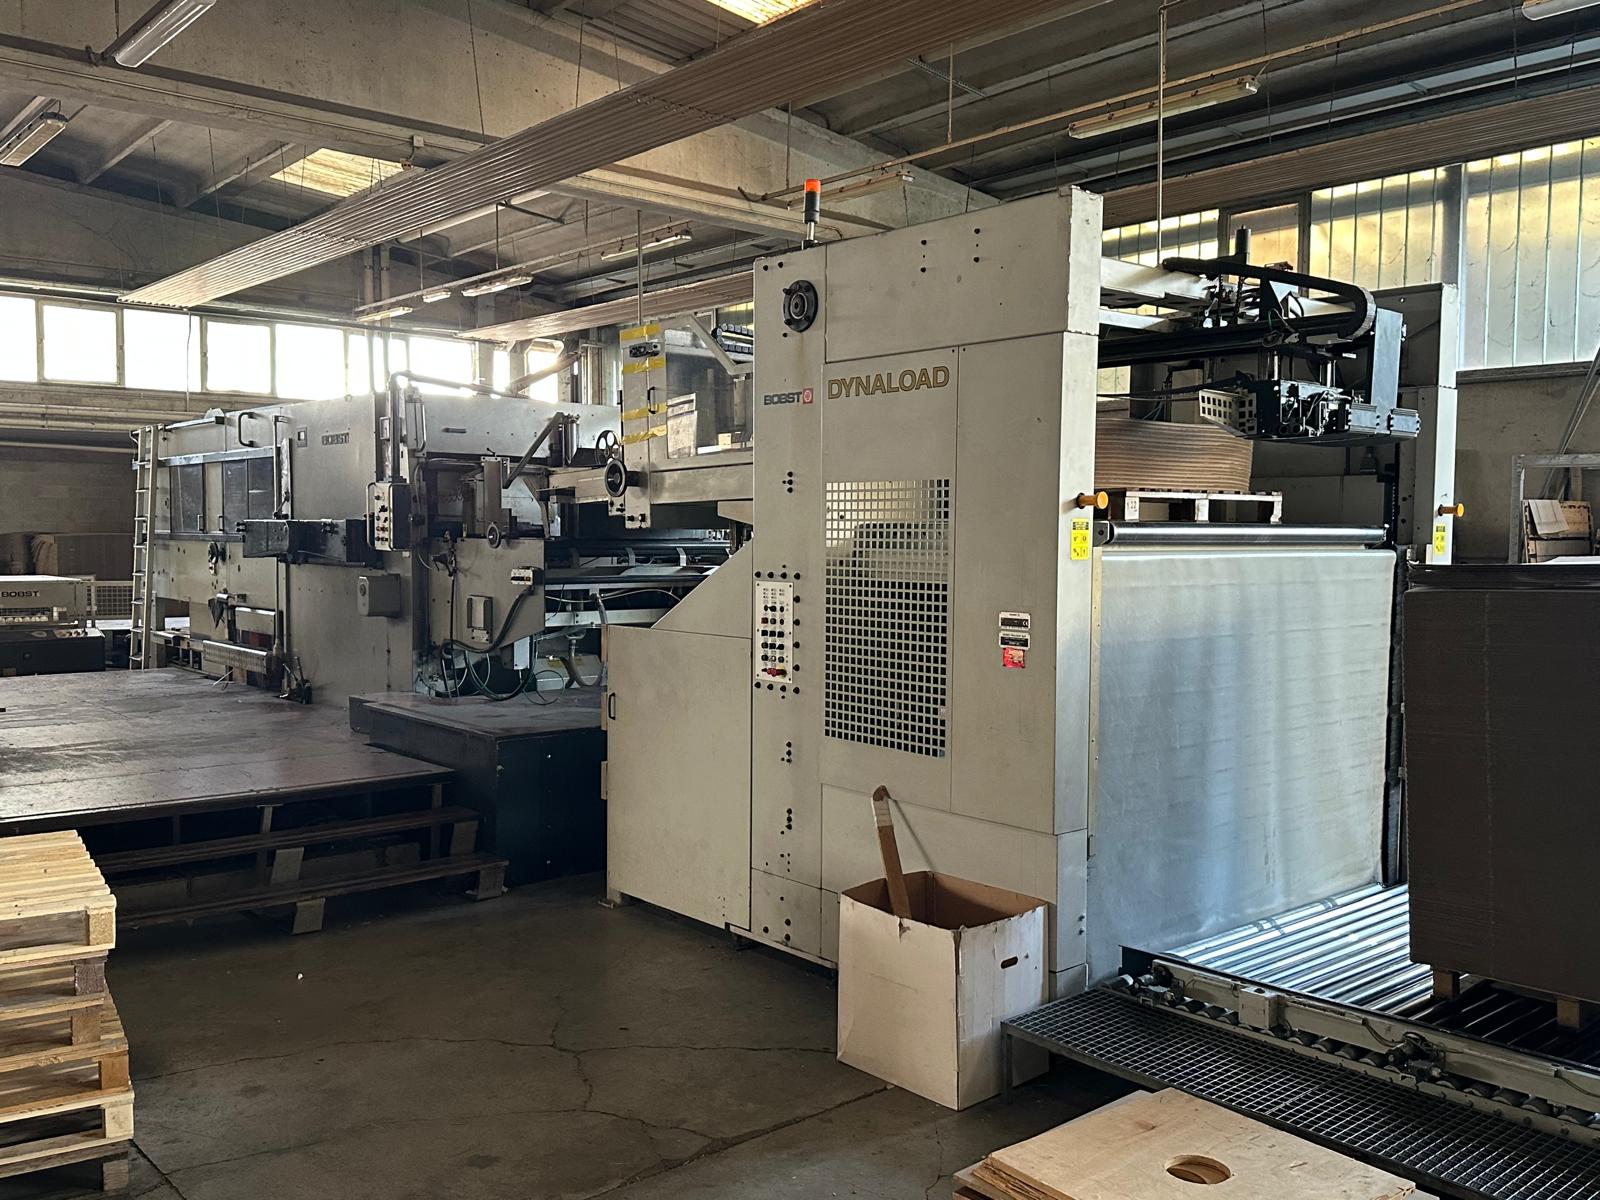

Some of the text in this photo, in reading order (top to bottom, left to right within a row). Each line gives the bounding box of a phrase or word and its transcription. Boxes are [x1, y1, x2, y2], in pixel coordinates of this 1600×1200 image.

[828, 366, 950, 400] DYNALOAD
[764, 391, 802, 405] BOBST
[322, 432, 349, 445] BOBST
